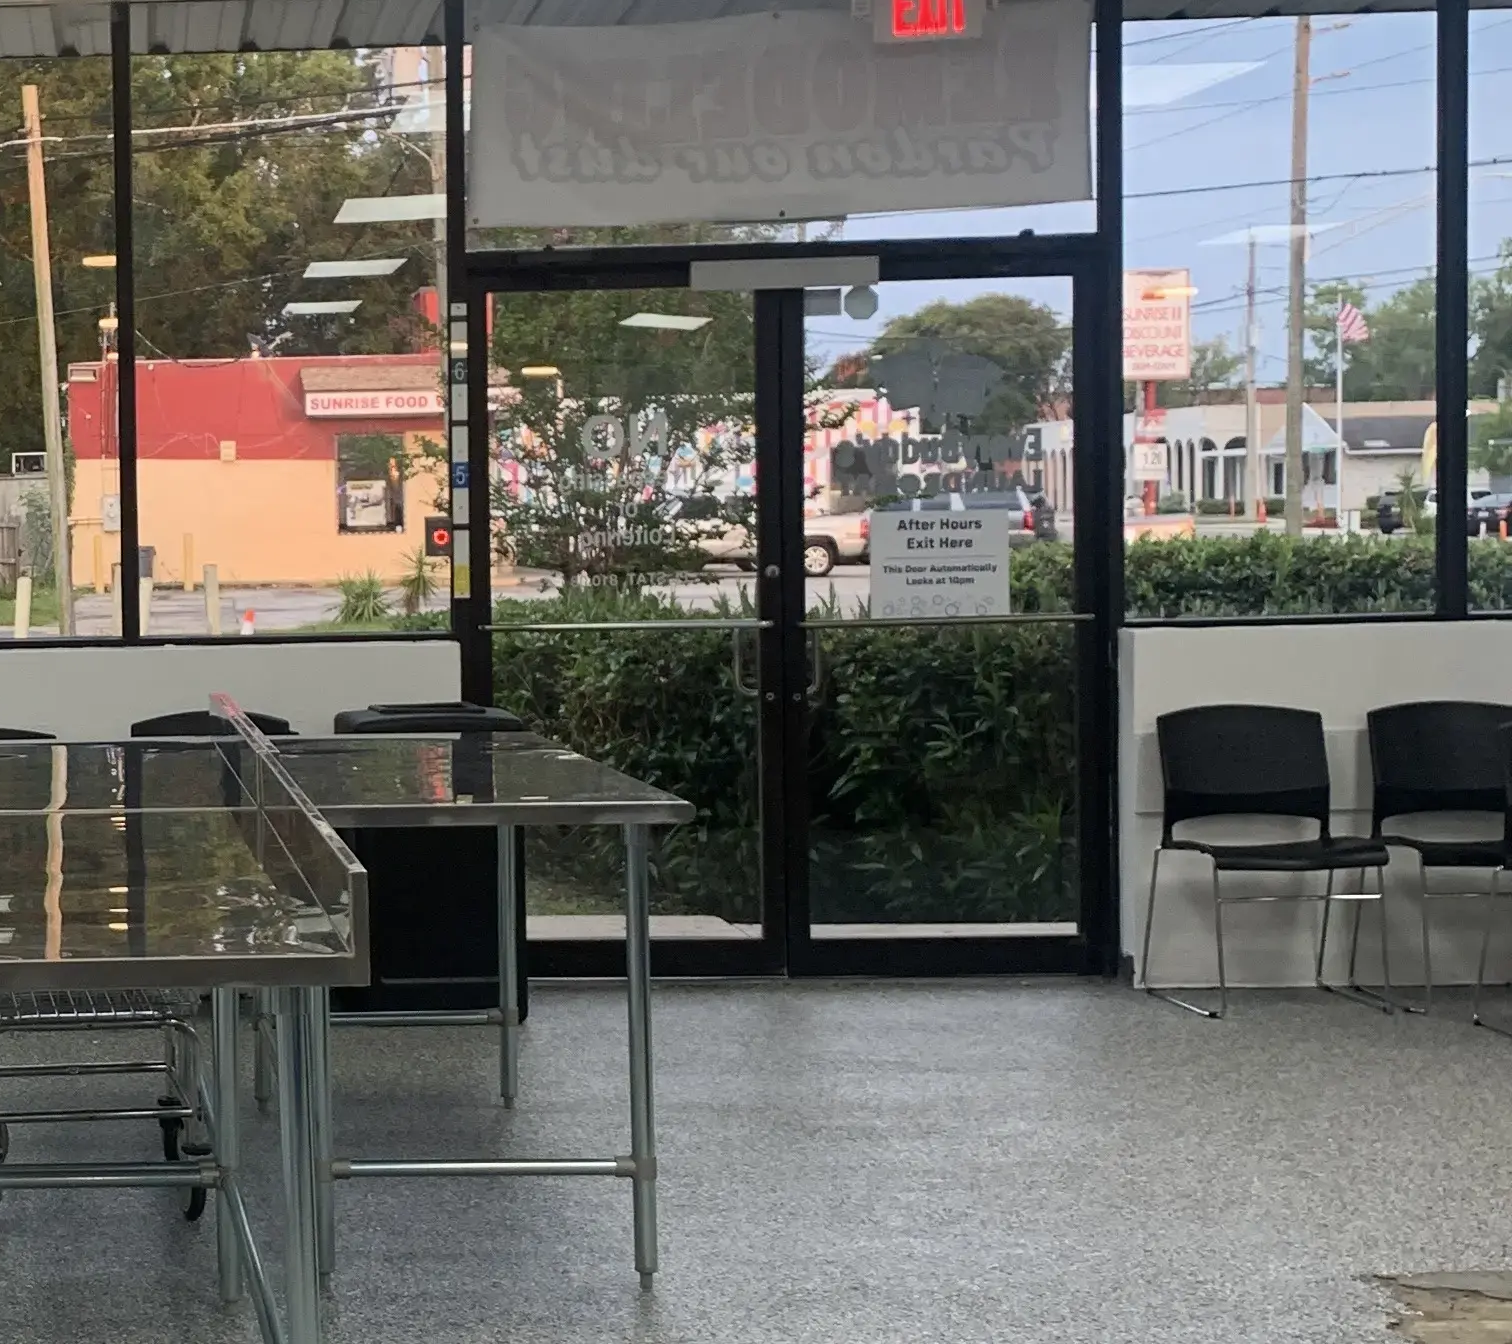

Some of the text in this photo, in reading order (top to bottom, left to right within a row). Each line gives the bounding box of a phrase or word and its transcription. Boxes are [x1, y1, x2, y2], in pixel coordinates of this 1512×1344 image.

[454, 362, 465, 380] 6
[310, 397, 380, 410] SUNRISE
[385, 396, 428, 408] FOOD
[456, 466, 466, 485] 5
[897, 518, 982, 531] After Hours
[907, 537, 973, 549] Exit Here
[883, 563, 998, 574] This Door Automatically
[936, 576, 946, 584] at
